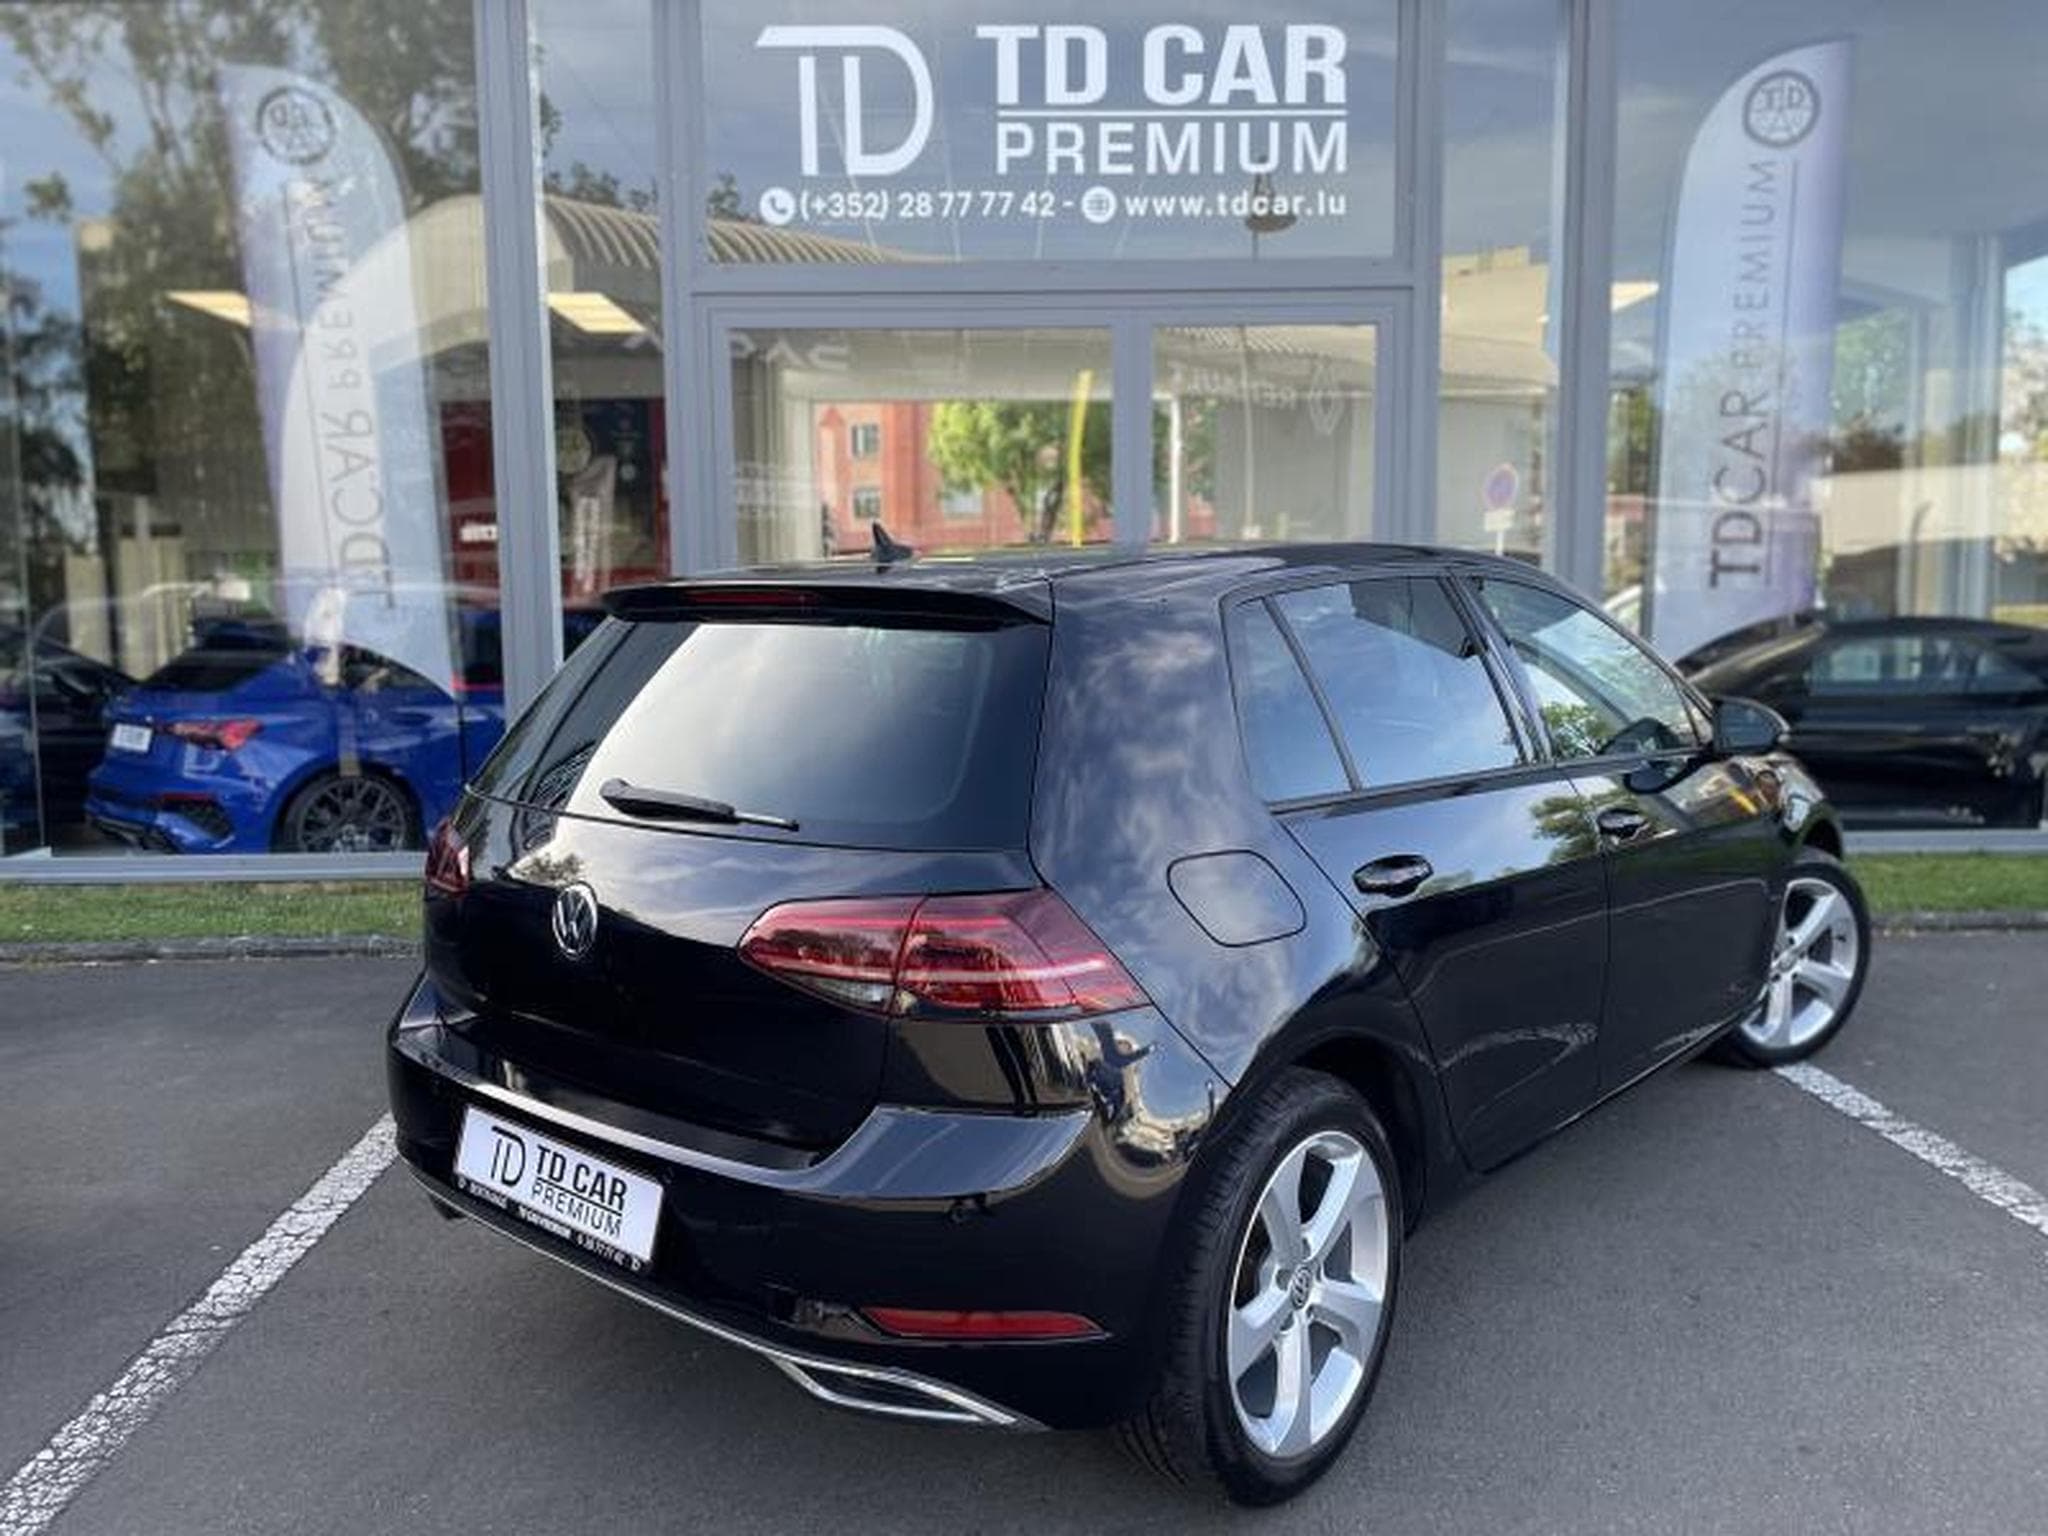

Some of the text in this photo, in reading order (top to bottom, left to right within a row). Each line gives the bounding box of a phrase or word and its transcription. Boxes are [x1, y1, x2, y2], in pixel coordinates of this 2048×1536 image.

[976, 24, 1347, 105] TD CAR
[997, 121, 1348, 175] PREMIUM
[800, 190, 890, 220] (+352)
[897, 192, 933, 218] 28
[938, 192, 973, 218] 77
[979, 192, 1016, 218] 77
[1020, 192, 1056, 218] 42
[1125, 191, 1347, 217] www.tdcar.lu
[1709, 159, 1781, 589] TDCAR PREMIUM
[536, 1143, 628, 1211] TD CAR
[531, 1181, 624, 1239] PREMIUM
